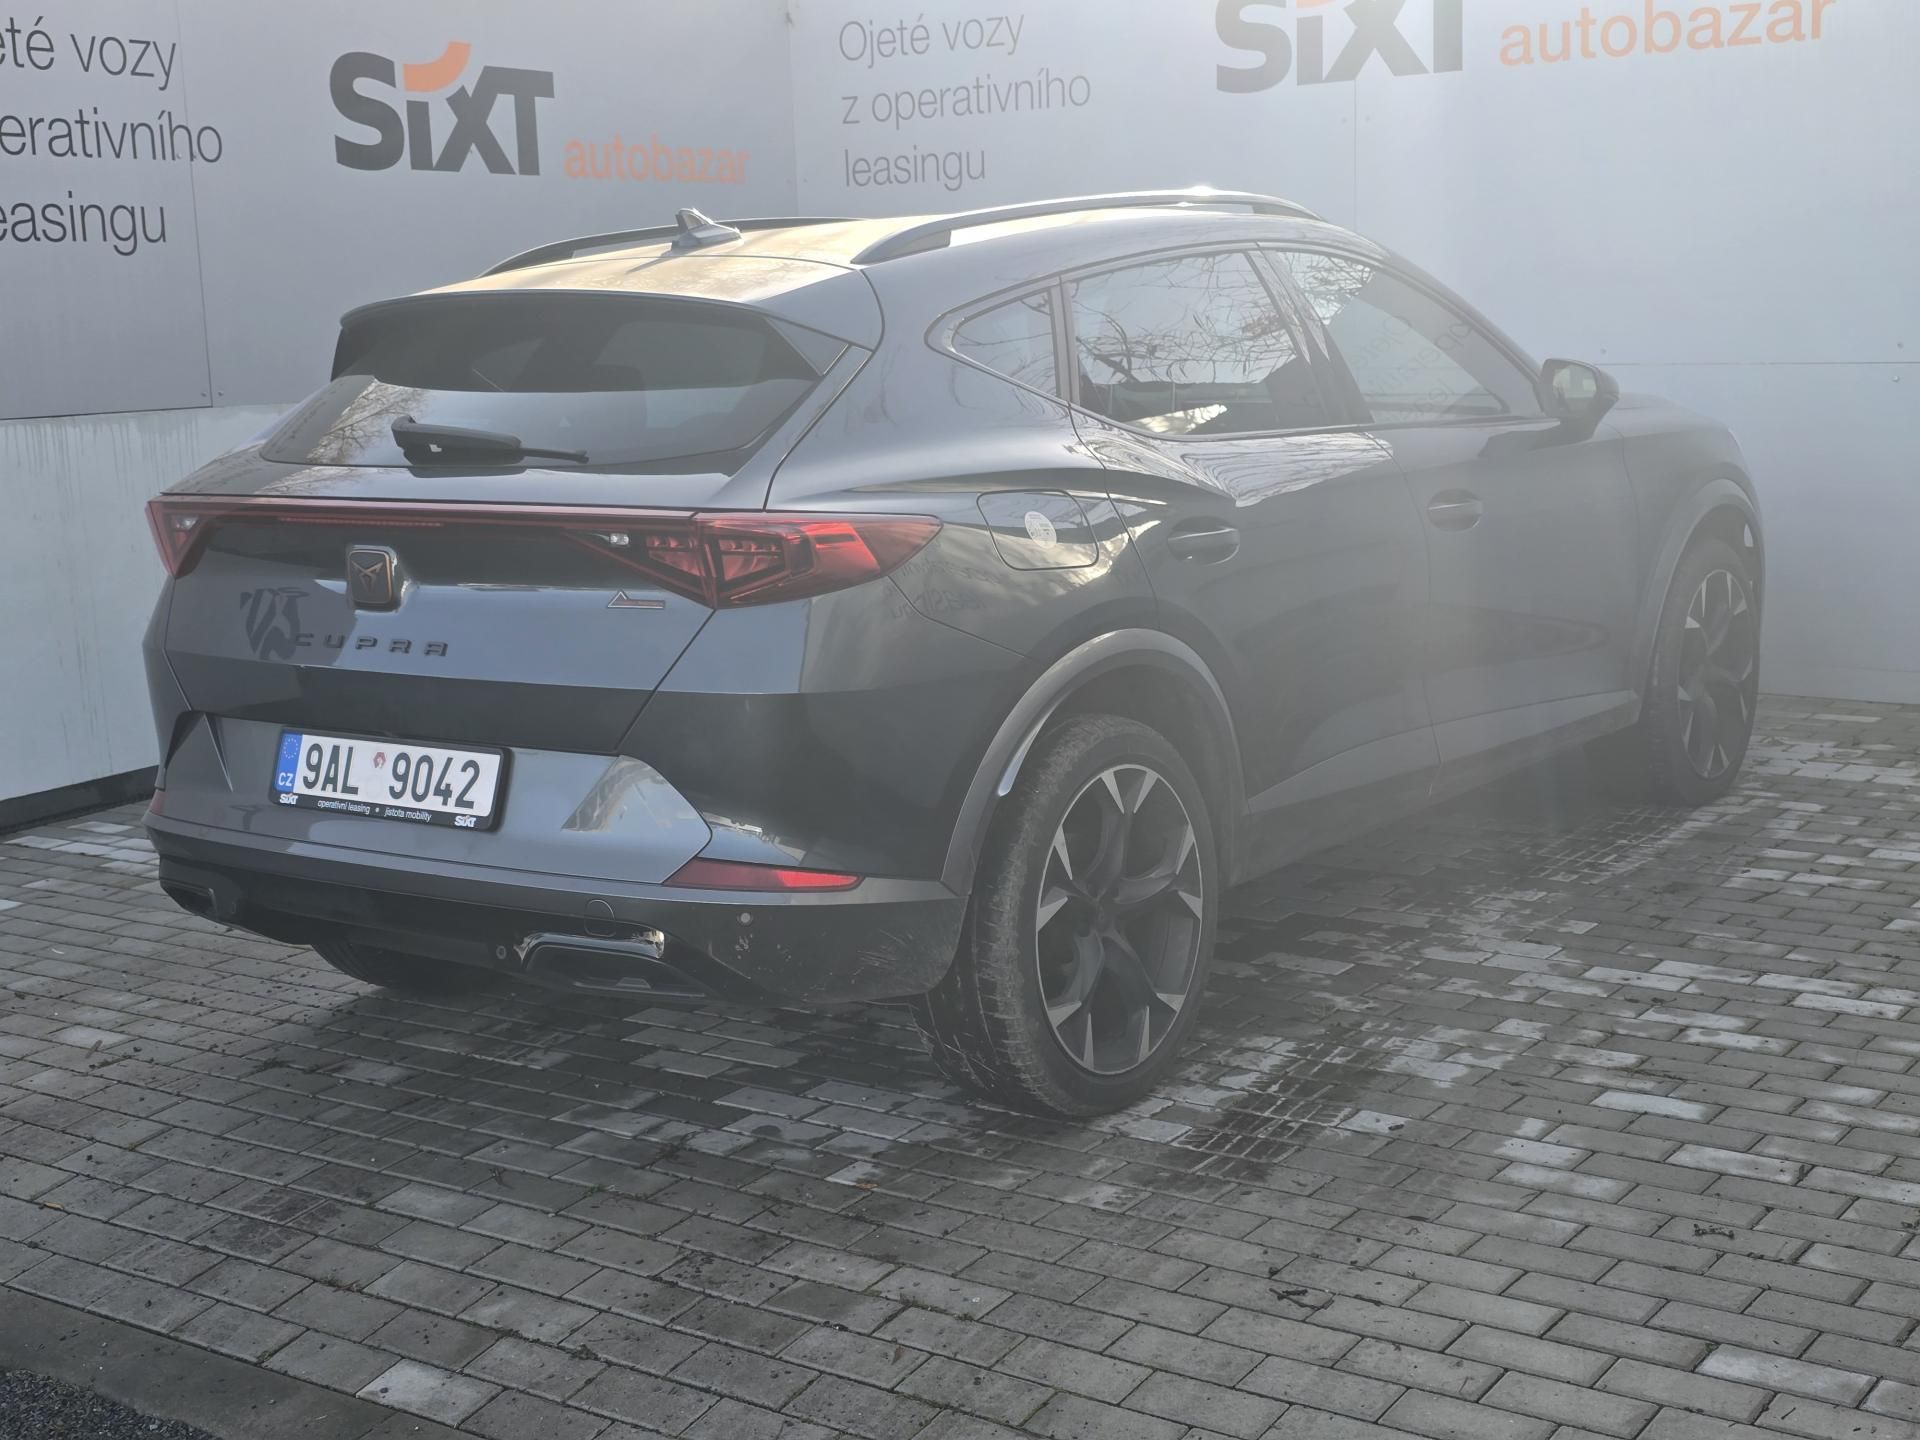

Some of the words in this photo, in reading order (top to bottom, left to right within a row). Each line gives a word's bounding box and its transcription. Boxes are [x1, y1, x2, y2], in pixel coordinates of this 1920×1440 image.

[0, 16, 55, 70] té
[70, 33, 176, 91] vozy
[839, 13, 930, 69] Ojeté
[942, 14, 1024, 56] vozy
[1499, 0, 1836, 66] autobazar
[842, 95, 861, 125] z
[872, 67, 1091, 130] operativního
[0, 107, 222, 163] erativního
[563, 134, 750, 184] autobazar
[845, 145, 985, 191] leasingu
[0, 190, 166, 256] asingu
[295, 632, 449, 658] CUPRA
[278, 771, 294, 788] CZ
[302, 743, 359, 796] 9AL
[388, 752, 480, 809] 9042
[347, 802, 371, 815] leasing
[384, 807, 405, 817] jistota
[405, 810, 432, 822] mobility
